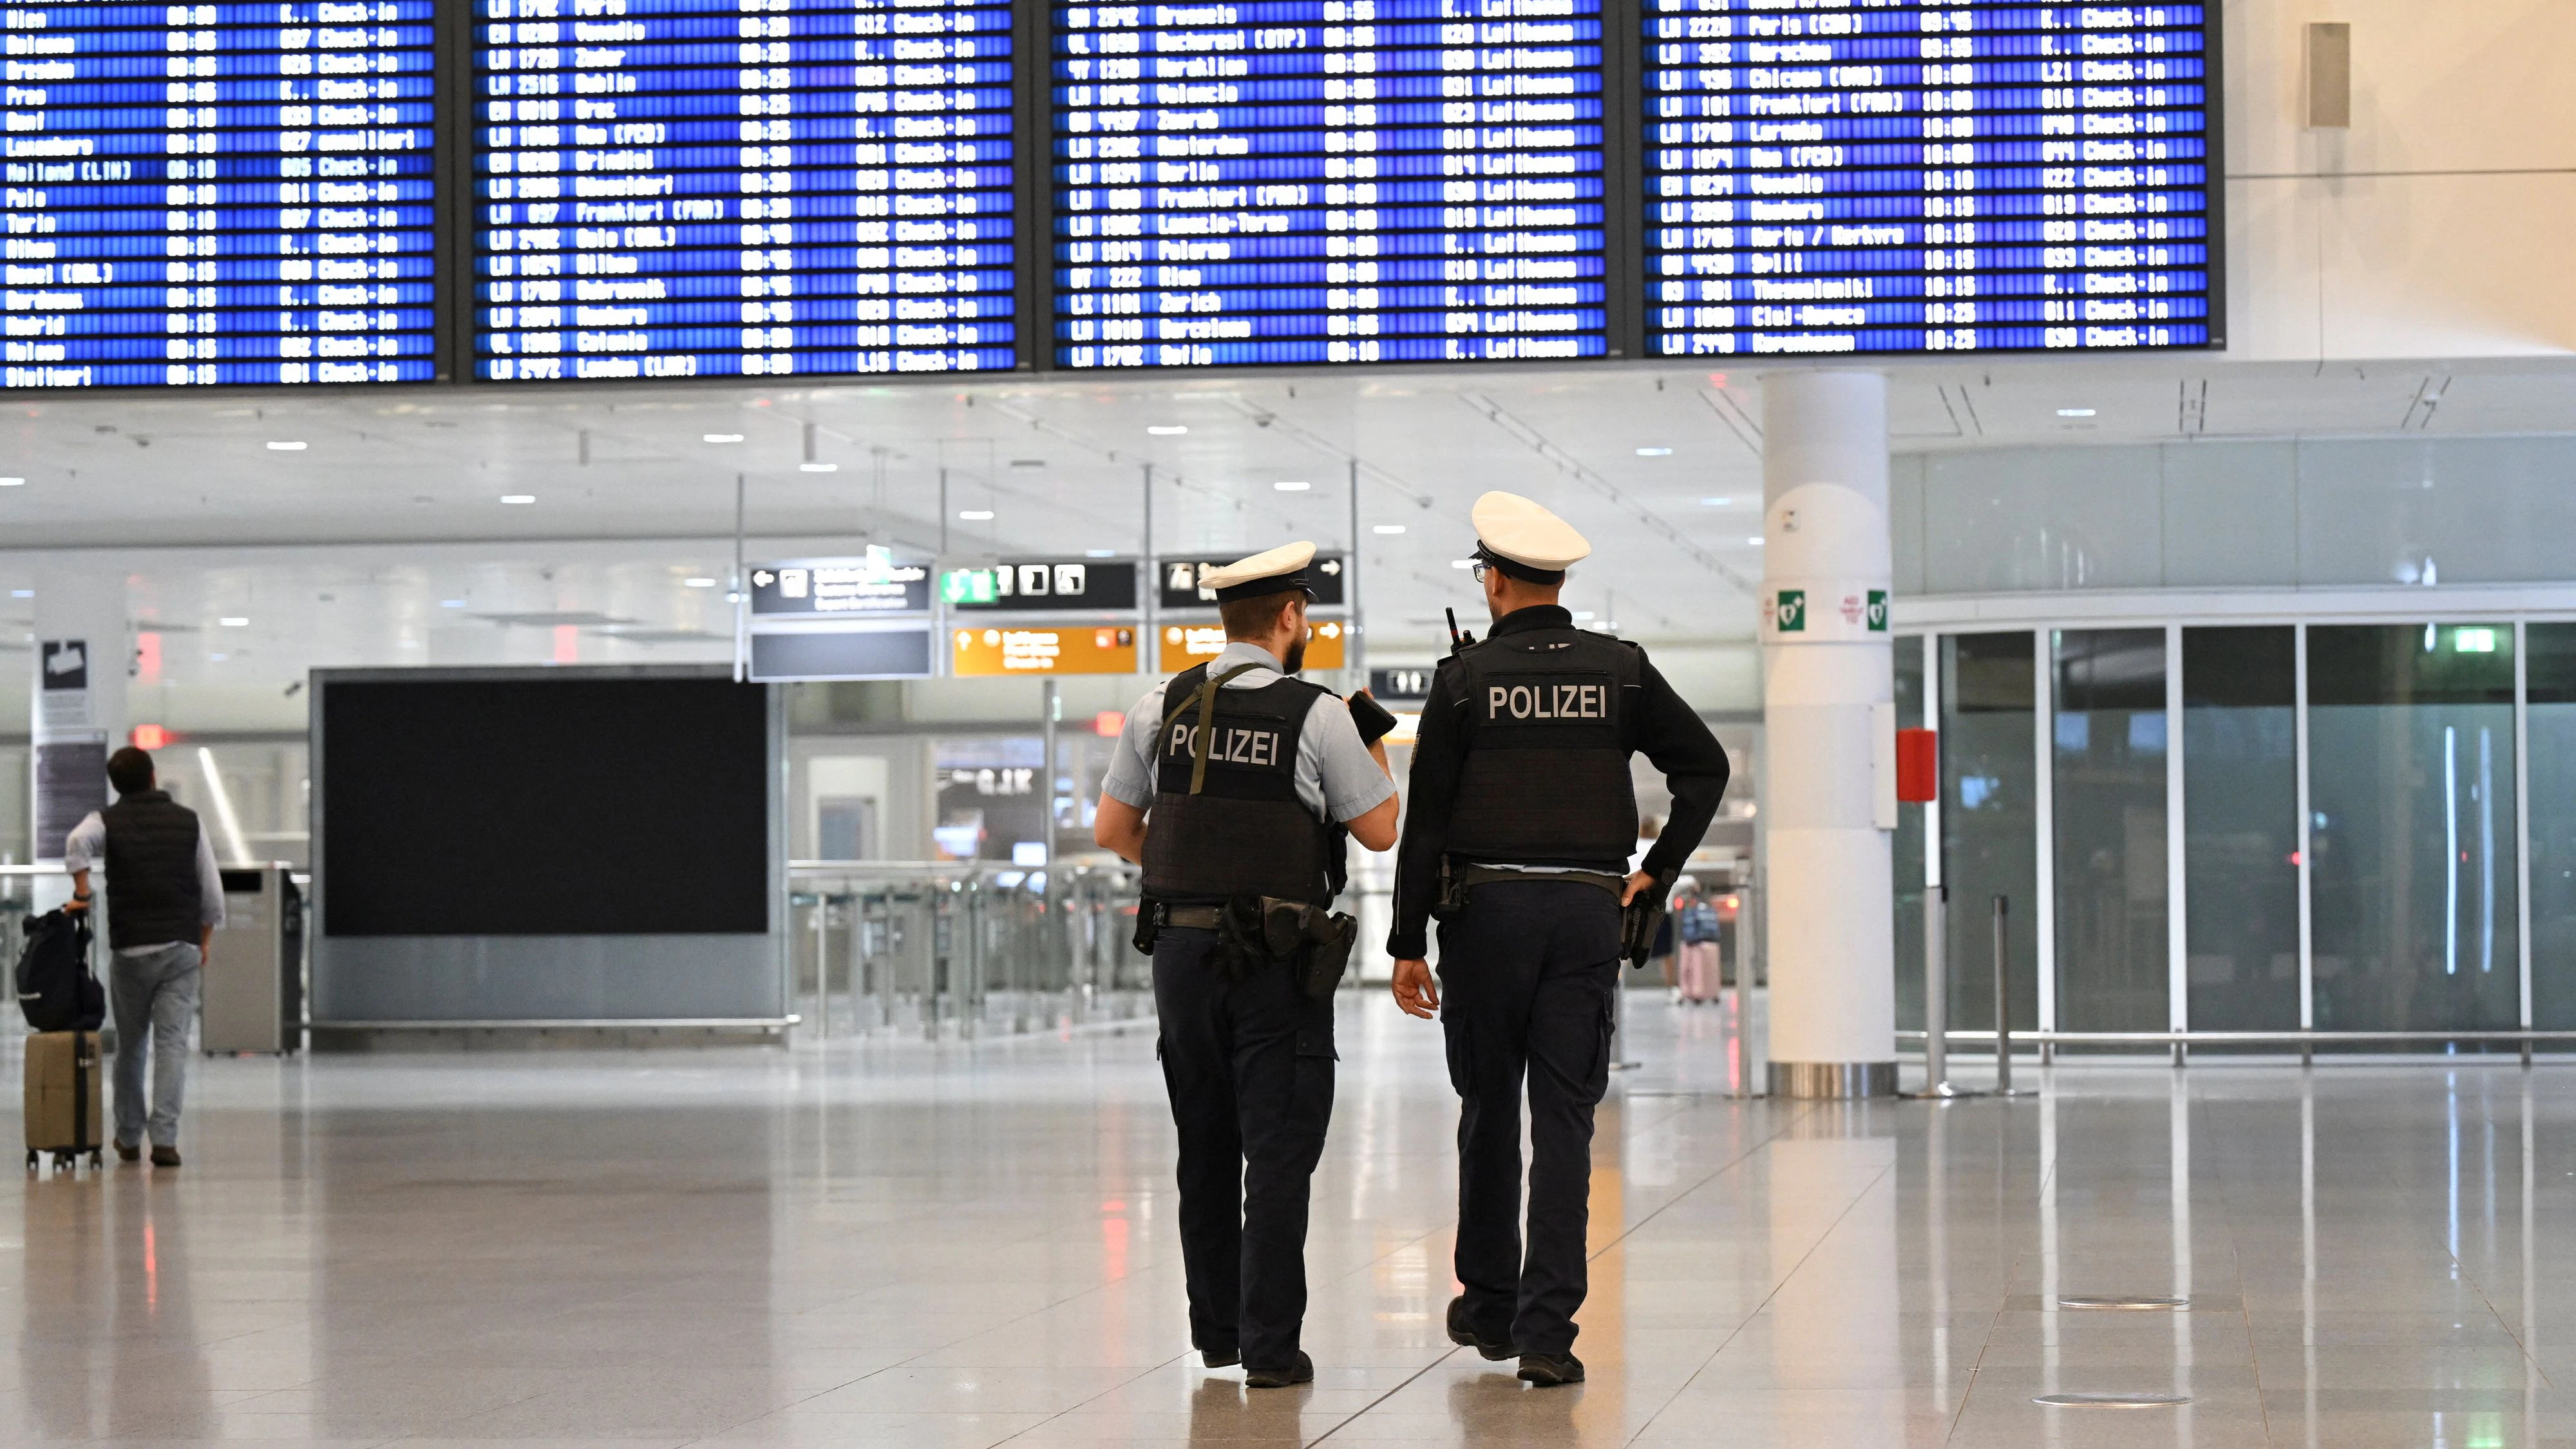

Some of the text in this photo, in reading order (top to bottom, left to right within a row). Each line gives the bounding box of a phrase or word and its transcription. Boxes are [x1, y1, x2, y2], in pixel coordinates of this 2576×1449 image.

[894, 13, 974, 33] Check-in
[2082, 7, 2164, 28] Check-in
[894, 39, 974, 59] Check-in
[2082, 33, 2164, 54] Check-in
[895, 64, 975, 85] Check-in
[2083, 61, 2165, 80] Check-in
[895, 91, 975, 111] Check-in
[2083, 87, 2165, 107] Check-in
[895, 117, 975, 137] Check-in
[2083, 113, 2166, 134] Check-in
[895, 142, 976, 163] Check-in
[2083, 140, 2166, 160] Check-in
[319, 158, 397, 176] Check-in
[2084, 167, 2166, 187] Check-in
[895, 168, 976, 189] Check-in
[896, 194, 976, 215] Check-in
[2084, 193, 2166, 213] Check-in
[896, 220, 976, 241] Check-in
[2085, 220, 2167, 240] Check-in
[896, 247, 976, 267] Check-in
[2085, 246, 2167, 267] Check-in
[896, 272, 977, 293] Check-in
[2085, 273, 2168, 293] Check-in
[896, 298, 977, 319] Check-in
[2085, 299, 2168, 320] Check-in
[897, 325, 977, 345] Check-in
[2086, 327, 2168, 346] Check-in
[897, 350, 978, 370] Check-in
[1489, 685, 1605, 719] POLIZEI
